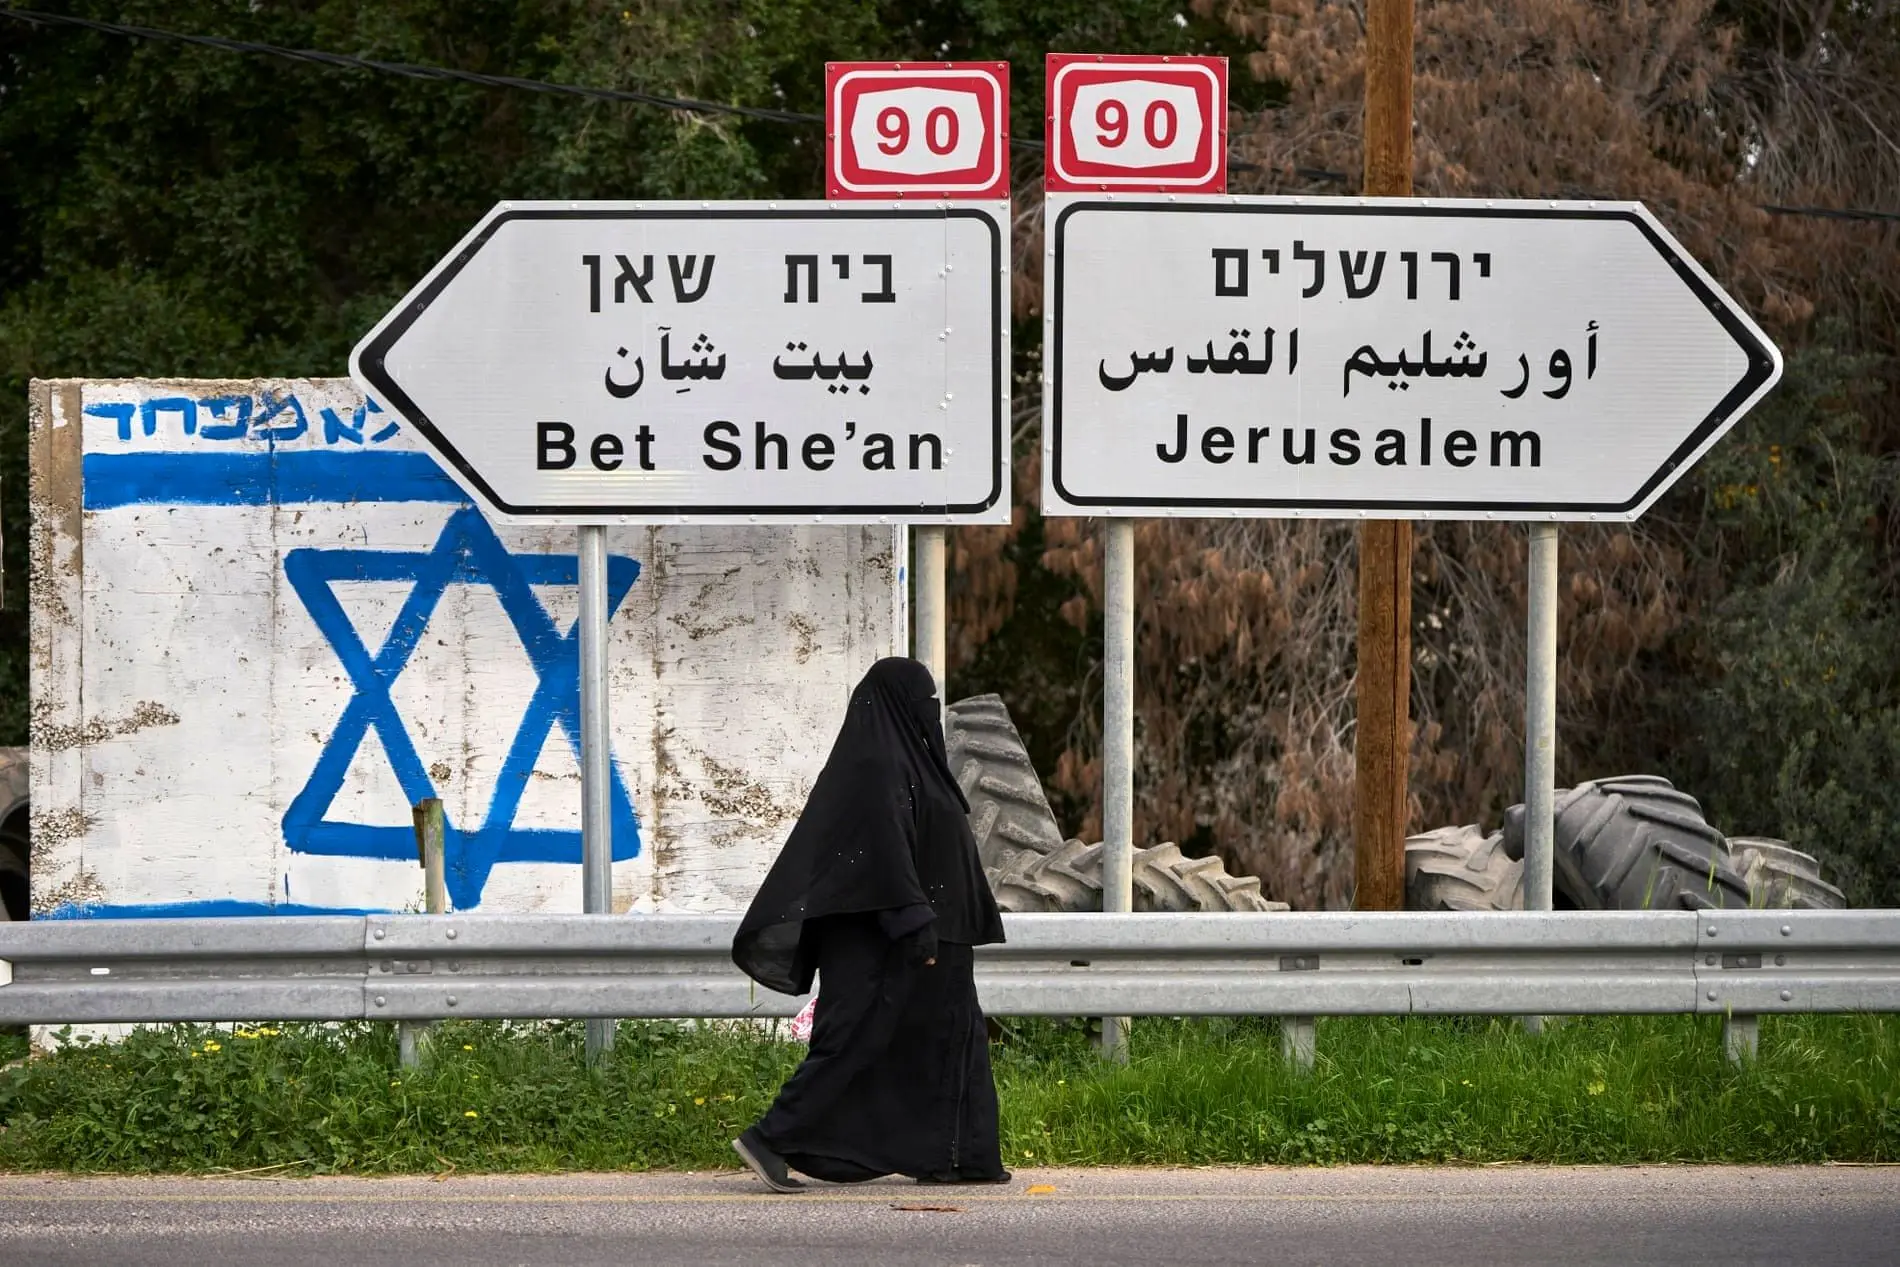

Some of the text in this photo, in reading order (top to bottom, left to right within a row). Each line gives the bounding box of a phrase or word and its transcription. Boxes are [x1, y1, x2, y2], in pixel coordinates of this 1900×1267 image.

[876, 106, 960, 156] 90
[1096, 99, 1178, 149] 90
[582, 254, 896, 313] בית שאן
[1211, 240, 1491, 301] ירושלים
[773, 341, 874, 396] بيت
[1098, 319, 1600, 400] أورشليم القدس
[83, 391, 309, 446] מפחד
[1156, 413, 1541, 468] Jerusalem
[536, 421, 656, 472] Bet
